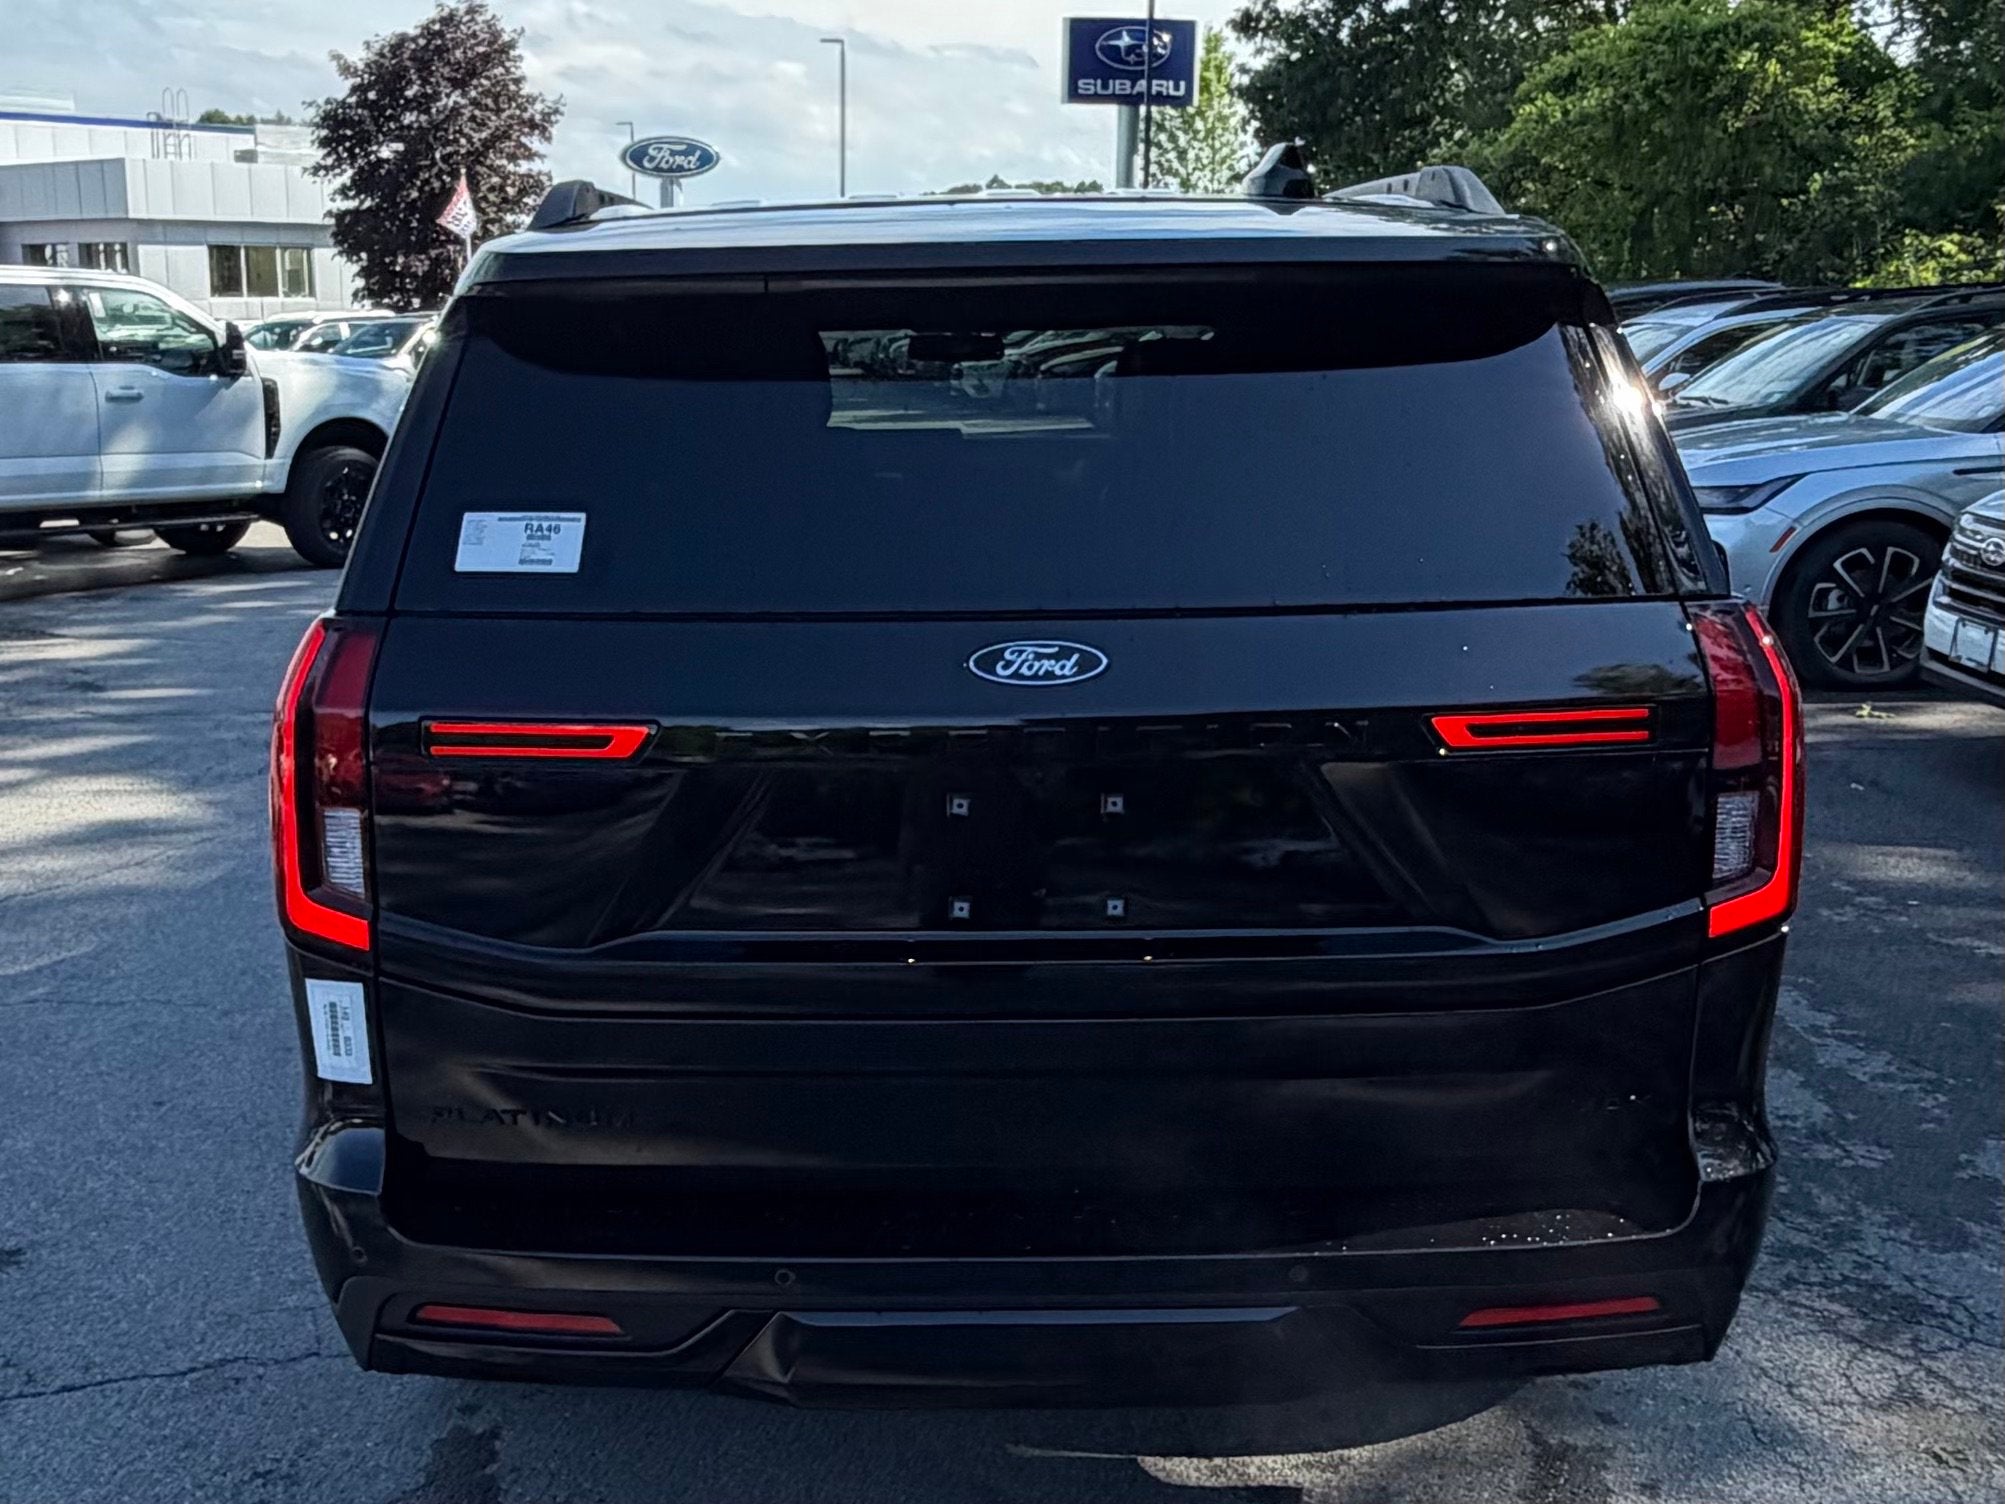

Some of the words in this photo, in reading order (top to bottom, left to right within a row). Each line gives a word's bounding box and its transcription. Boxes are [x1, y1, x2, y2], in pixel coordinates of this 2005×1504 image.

[1077, 79, 1186, 96] SUBARU
[642, 143, 702, 169] Ford
[524, 522, 561, 534] RA46
[996, 646, 1080, 676] Ford
